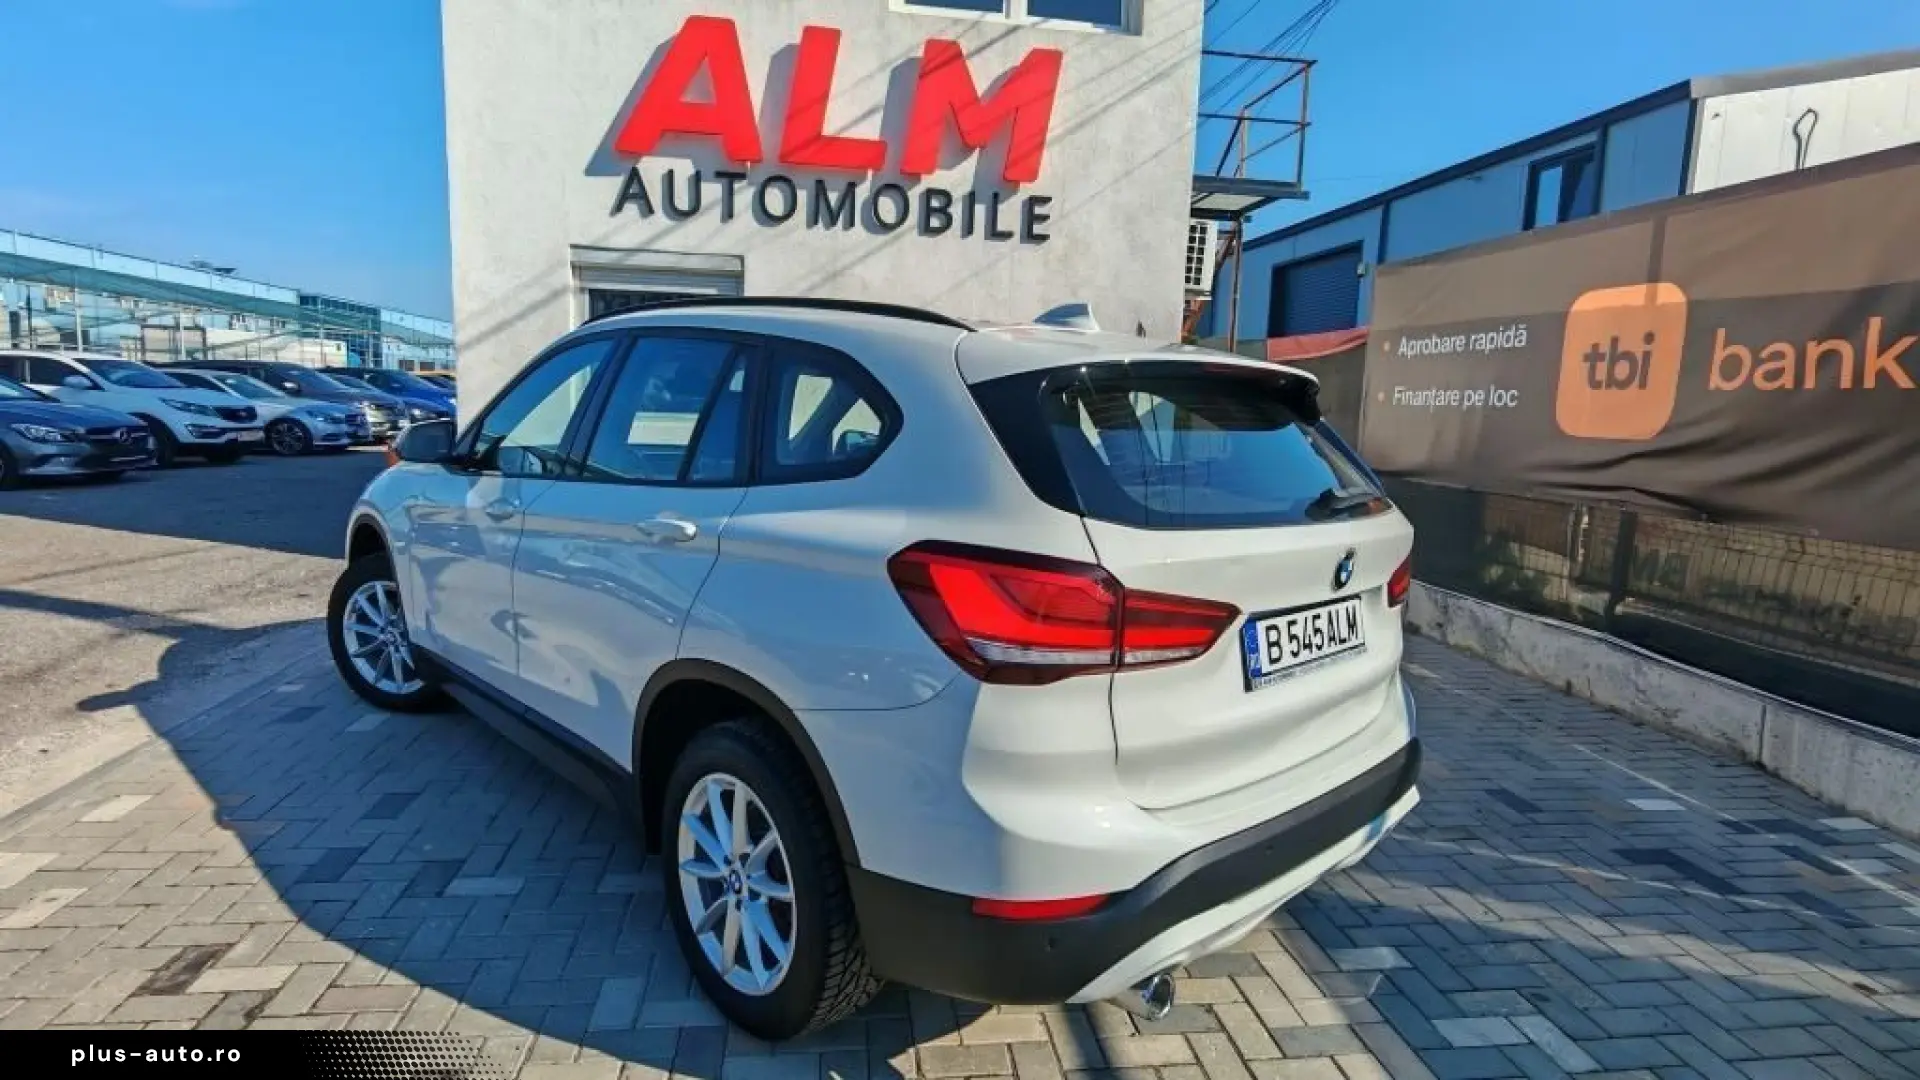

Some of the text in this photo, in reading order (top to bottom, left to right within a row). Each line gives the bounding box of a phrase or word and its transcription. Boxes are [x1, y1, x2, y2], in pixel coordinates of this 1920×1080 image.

[613, 15, 1064, 183] ALM
[610, 166, 1053, 241] AUTOMOBILE
[1397, 323, 1528, 360] Aprobare rapidă
[1582, 315, 1918, 391] tbi bank
[1463, 388, 1486, 412] pe
[1488, 383, 1519, 407] loc
[1265, 604, 1358, 664] B 545 ALM
